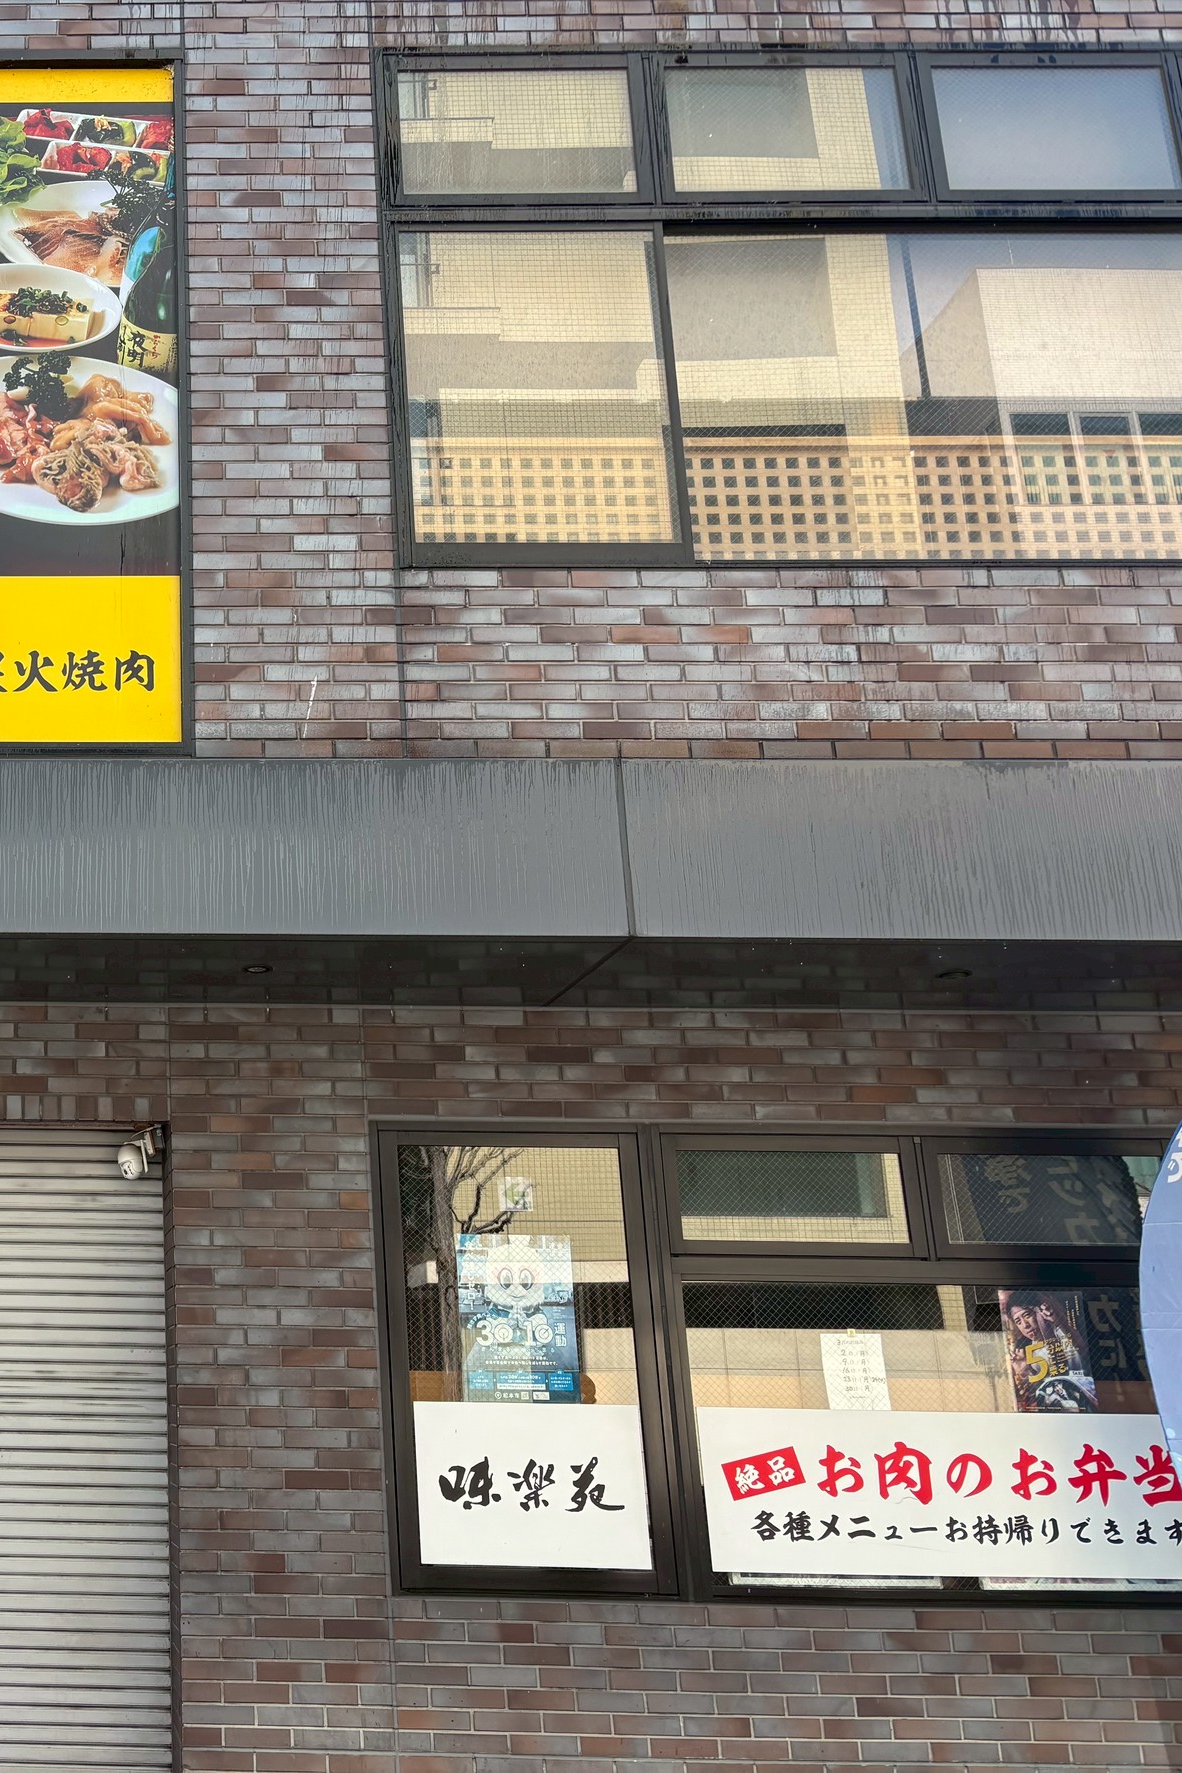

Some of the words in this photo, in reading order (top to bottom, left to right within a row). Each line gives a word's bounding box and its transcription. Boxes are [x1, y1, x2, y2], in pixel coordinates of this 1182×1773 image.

[1025, 1341, 1049, 1383] 5
[734, 1455, 795, 1494] 絶品
[817, 1441, 1182, 1507] お肉のお弁当
